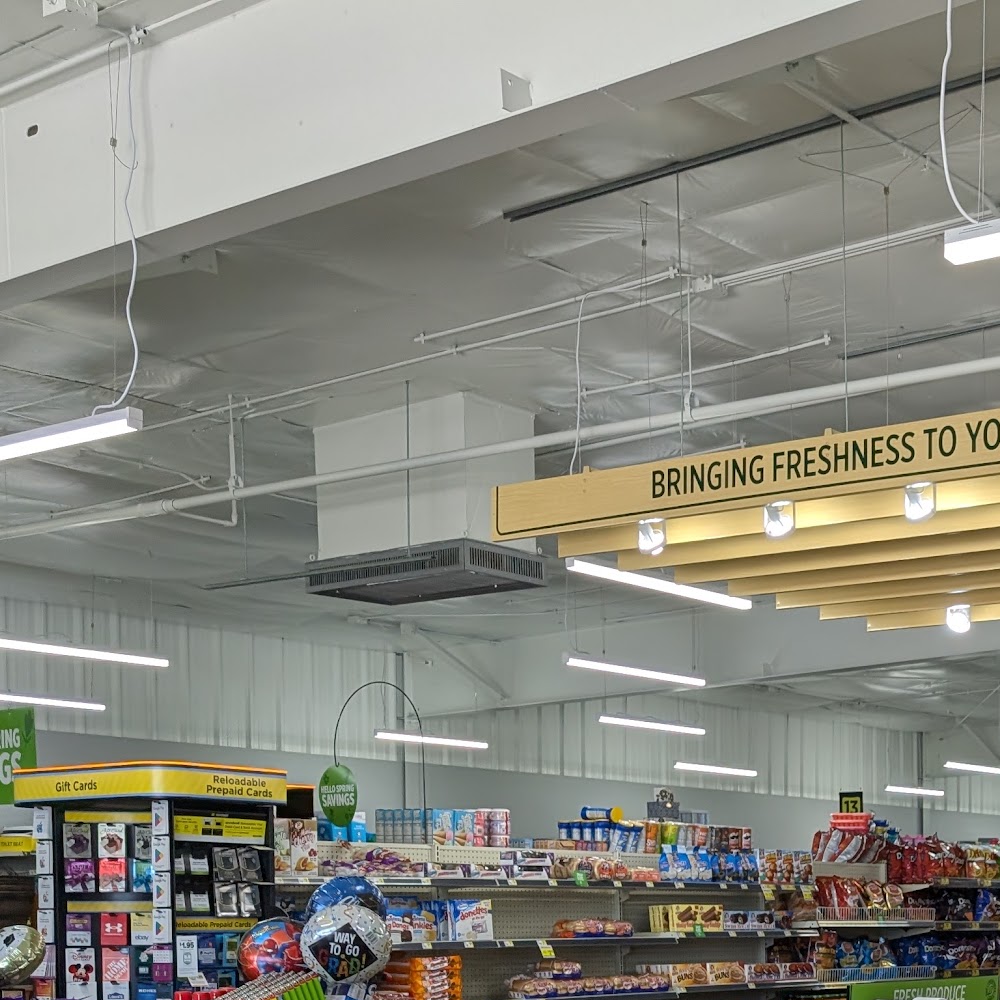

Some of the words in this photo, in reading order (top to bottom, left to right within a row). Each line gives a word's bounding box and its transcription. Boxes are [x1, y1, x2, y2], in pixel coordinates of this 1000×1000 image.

[651, 461, 765, 498] BRINGING
[772, 432, 916, 481] FRESHNESS
[924, 426, 958, 460] TO
[56, 781, 70, 793] Gift
[74, 780, 98, 791] Cards
[213, 775, 266, 788] Reloadable
[206, 785, 244, 796] Prepaid
[246, 788, 272, 798] Cards
[320, 784, 336, 793] HELLO
[336, 784, 354, 792] SPRING
[322, 792, 355, 806] SAVINGS
[334, 932, 357, 946] WAY
[329, 944, 342, 955] TO
[345, 945, 360, 956] GO
